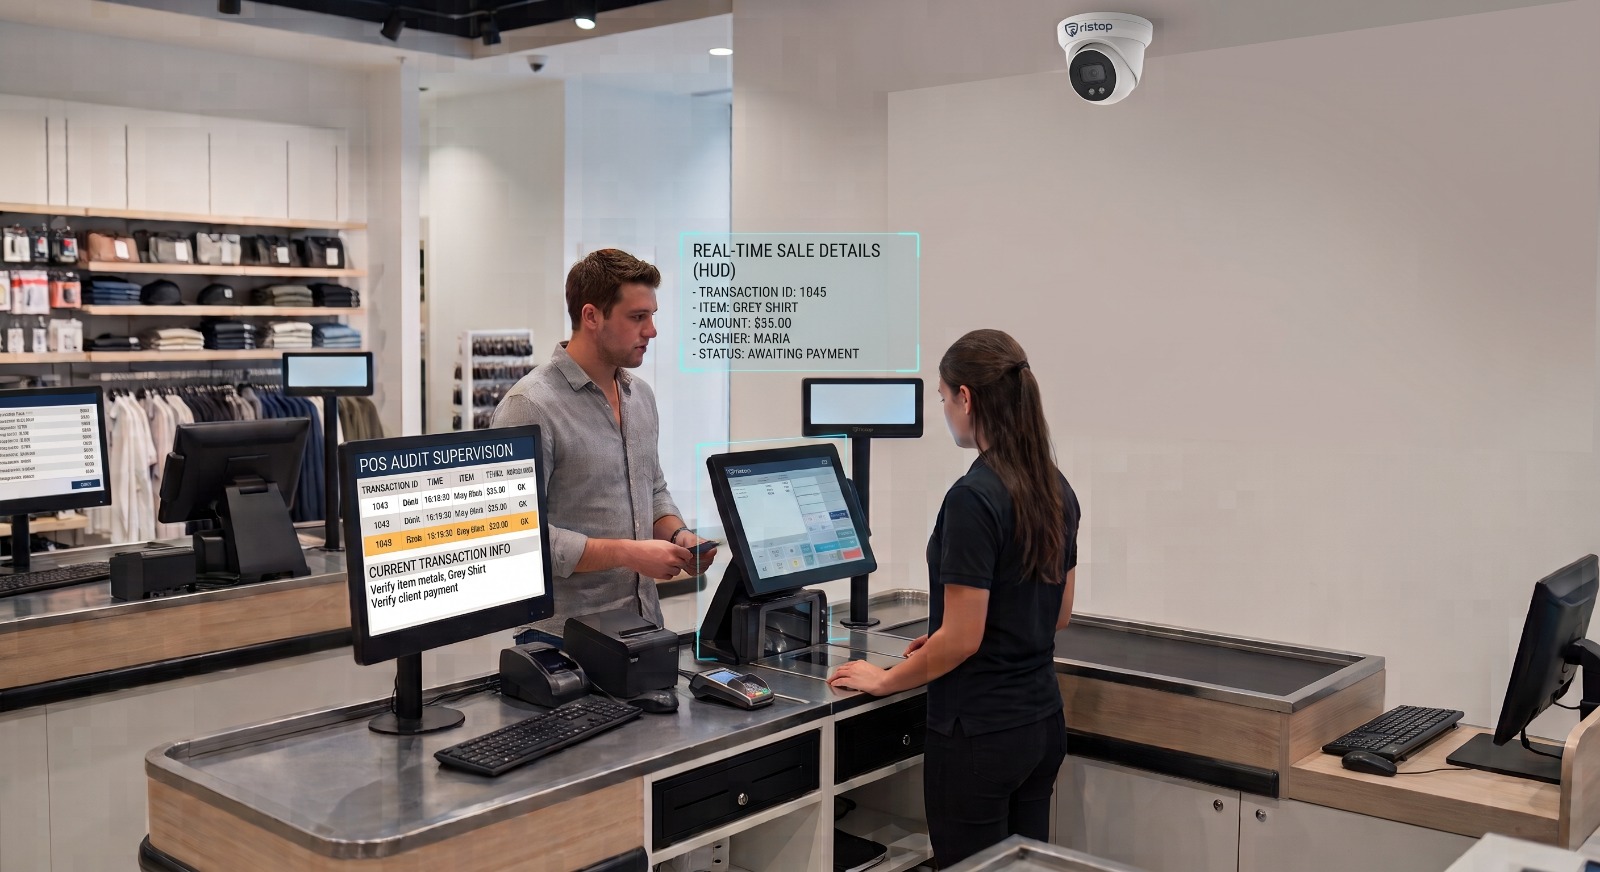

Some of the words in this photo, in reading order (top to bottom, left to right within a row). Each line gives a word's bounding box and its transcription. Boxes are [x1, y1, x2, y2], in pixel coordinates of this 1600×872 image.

[1079, 22, 1113, 33] ristop
[359, 456, 388, 473] POS
[390, 451, 430, 470] AUDIT
[433, 442, 514, 465] SUPERVISION
[361, 481, 411, 495] TRANSACTION
[411, 480, 419, 489] ID
[426, 476, 444, 487] TIME
[459, 473, 475, 483] ITEM
[372, 501, 389, 511] 1043
[486, 485, 506, 496] $35.00
[374, 519, 390, 530] 1043
[487, 502, 508, 513] $25.00
[369, 559, 417, 579] CURRENT
[418, 546, 487, 570] TRANSACTION
[489, 542, 511, 557] INFO
[370, 581, 395, 595] Verify
[397, 578, 417, 590] item
[418, 571, 446, 586] metals,
[447, 569, 466, 580] Grey
[467, 564, 487, 576] Shirt
[370, 594, 397, 609] Verify
[398, 590, 422, 604] client
[423, 583, 459, 601] payment
